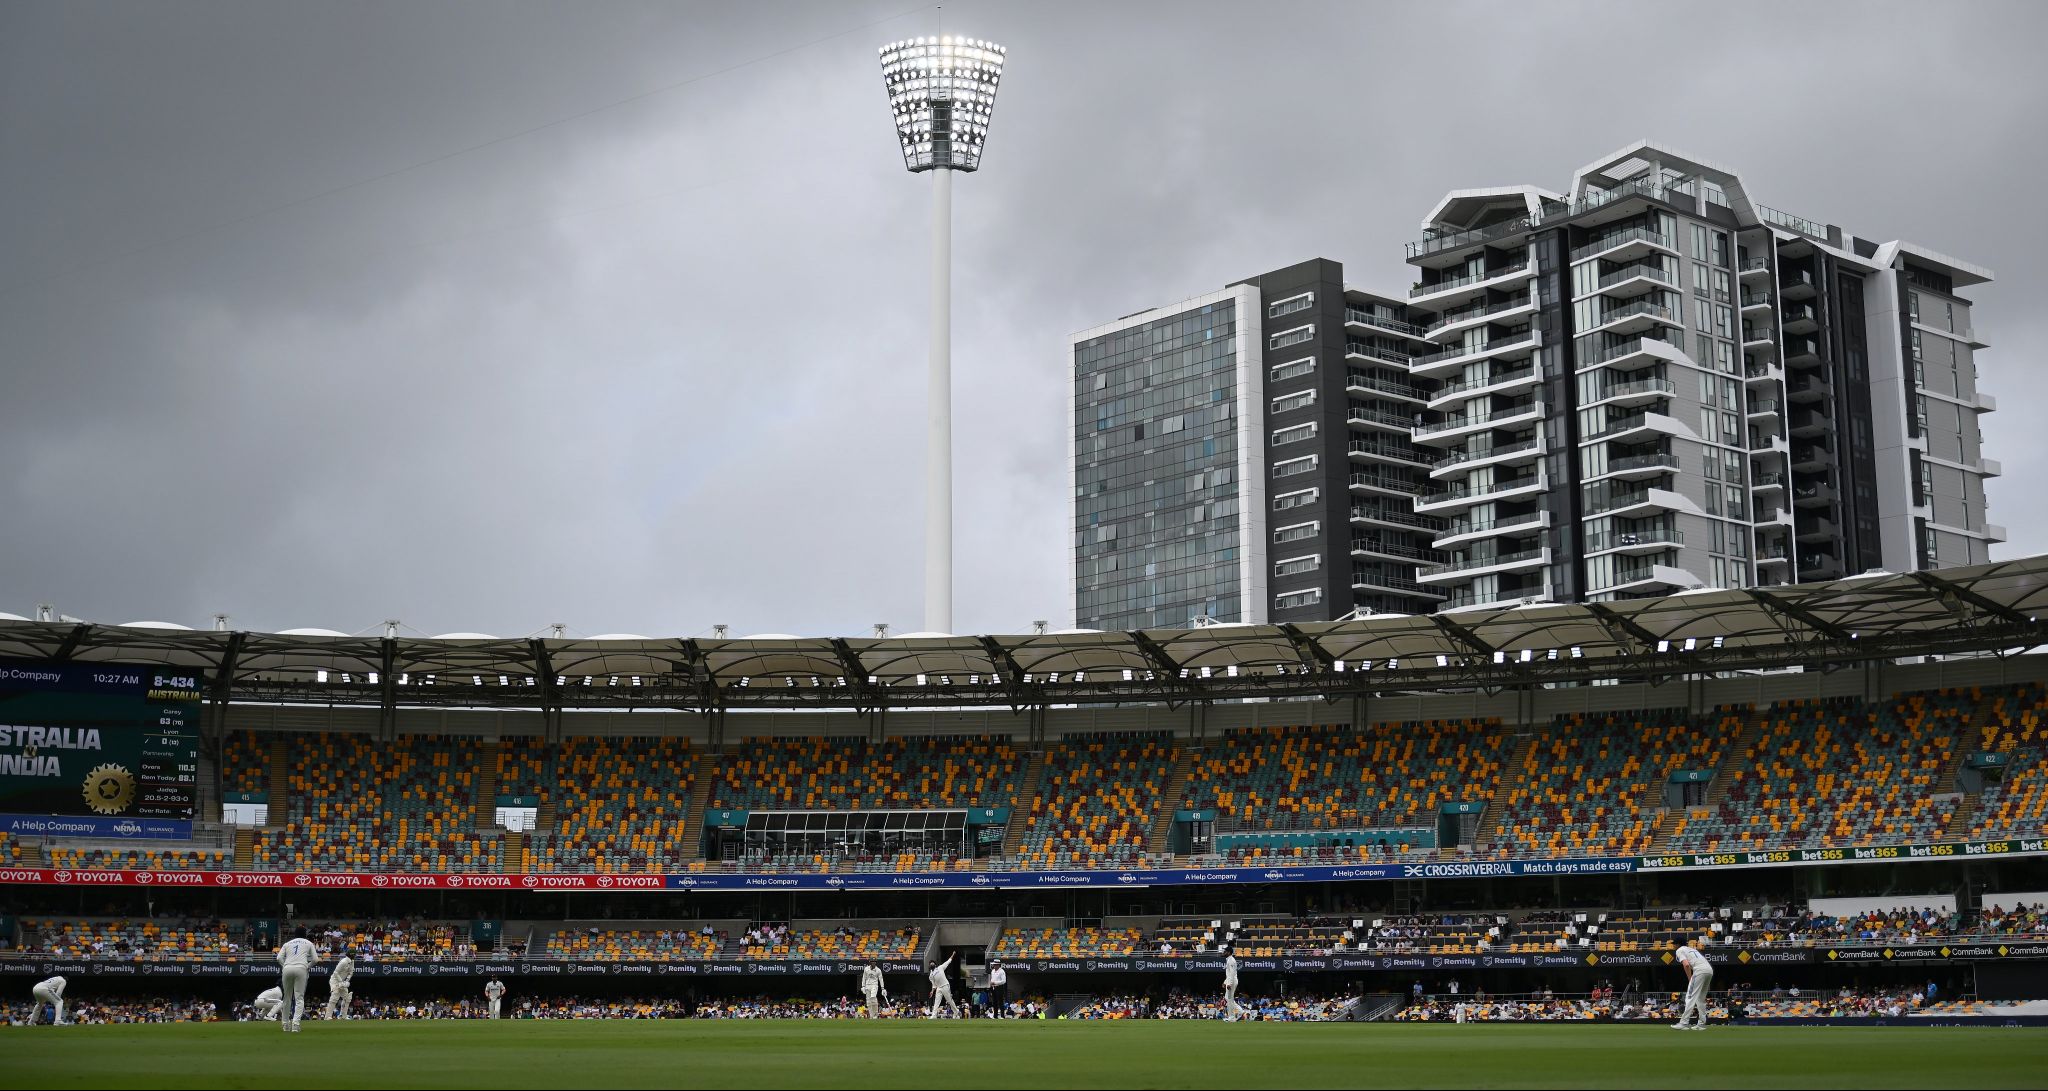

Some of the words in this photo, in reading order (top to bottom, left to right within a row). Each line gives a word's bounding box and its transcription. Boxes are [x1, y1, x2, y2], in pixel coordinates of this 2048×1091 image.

[11, 670, 61, 682] Company
[93, 673, 120, 684] 10:27
[122, 675, 139, 685] AM
[154, 676, 195, 689] 8-434
[147, 690, 200, 700] AUSTRALIA
[12, 821, 20, 830] A
[22, 821, 46, 832] Help
[48, 822, 96, 833] Company
[1855, 847, 1898, 858] bet365
[1910, 845, 1954, 856] bet365
[1966, 842, 2009, 854] bet365
[1748, 852, 1789, 863] bet365
[1802, 849, 1843, 860] bet365
[1643, 857, 1684, 867] bet365
[1695, 855, 1736, 865] bet365
[1425, 863, 1515, 876] CROSSRIVERRAIL
[1523, 863, 1552, 872] Match
[1555, 862, 1578, 874] days
[1581, 861, 1607, 870] made
[1610, 862, 1632, 872] easy
[0, 872, 41, 881] OYOTA
[75, 872, 123, 882] TOYOTA
[156, 873, 203, 883] TOYOTA
[1191, 873, 1206, 881] Help
[1207, 872, 1237, 881] Company
[1339, 870, 1354, 878] Help
[1354, 869, 1386, 878] Company
[237, 875, 282, 884] TOYOTA
[315, 876, 360, 885] TOYOTA
[391, 876, 436, 885] TOYOTA
[466, 876, 511, 885] TOYOTA
[542, 877, 586, 886] TOYOTA
[616, 878, 660, 886] TOYOTA
[752, 878, 767, 887] Help
[768, 878, 799, 887] Company
[899, 877, 914, 885] Help
[914, 877, 945, 886] Company
[1060, 875, 1091, 883] Company
[1838, 951, 1880, 959] CommBank
[1894, 949, 1936, 957] CommBank
[1952, 947, 1994, 956] CommBank
[1495, 957, 1526, 965] Remitly
[1545, 956, 1577, 964] Remitly
[1600, 955, 1651, 964] CommBank
[1753, 952, 1806, 961] CommBank
[1049, 962, 1079, 970] Remitly
[1098, 961, 1128, 970] Remitly
[1147, 961, 1177, 969] Remitly
[1245, 961, 1275, 969] Remitly
[1295, 960, 1325, 968] Remitly
[1344, 959, 1375, 967] Remitly
[1394, 958, 1425, 967] Remitly
[1444, 957, 1475, 966] Remitly
[4, 965, 35, 974] Remitly
[54, 965, 86, 974] Remitly
[104, 965, 135, 974] Remitly
[153, 965, 184, 974] Remitly
[202, 965, 233, 974] Remitly
[250, 966, 280, 974] Remitly
[393, 966, 422, 974] Remitly
[440, 966, 469, 974] Remitly
[485, 965, 515, 974] Remitly
[532, 965, 561, 974] Remitly
[577, 965, 606, 974] Remitly
[623, 965, 651, 974] Remitly
[668, 965, 697, 974] Remitly
[713, 965, 742, 974] Remitly
[758, 965, 787, 974] Remitly
[803, 965, 832, 974] Remitly
[892, 964, 921, 972] Remitly
